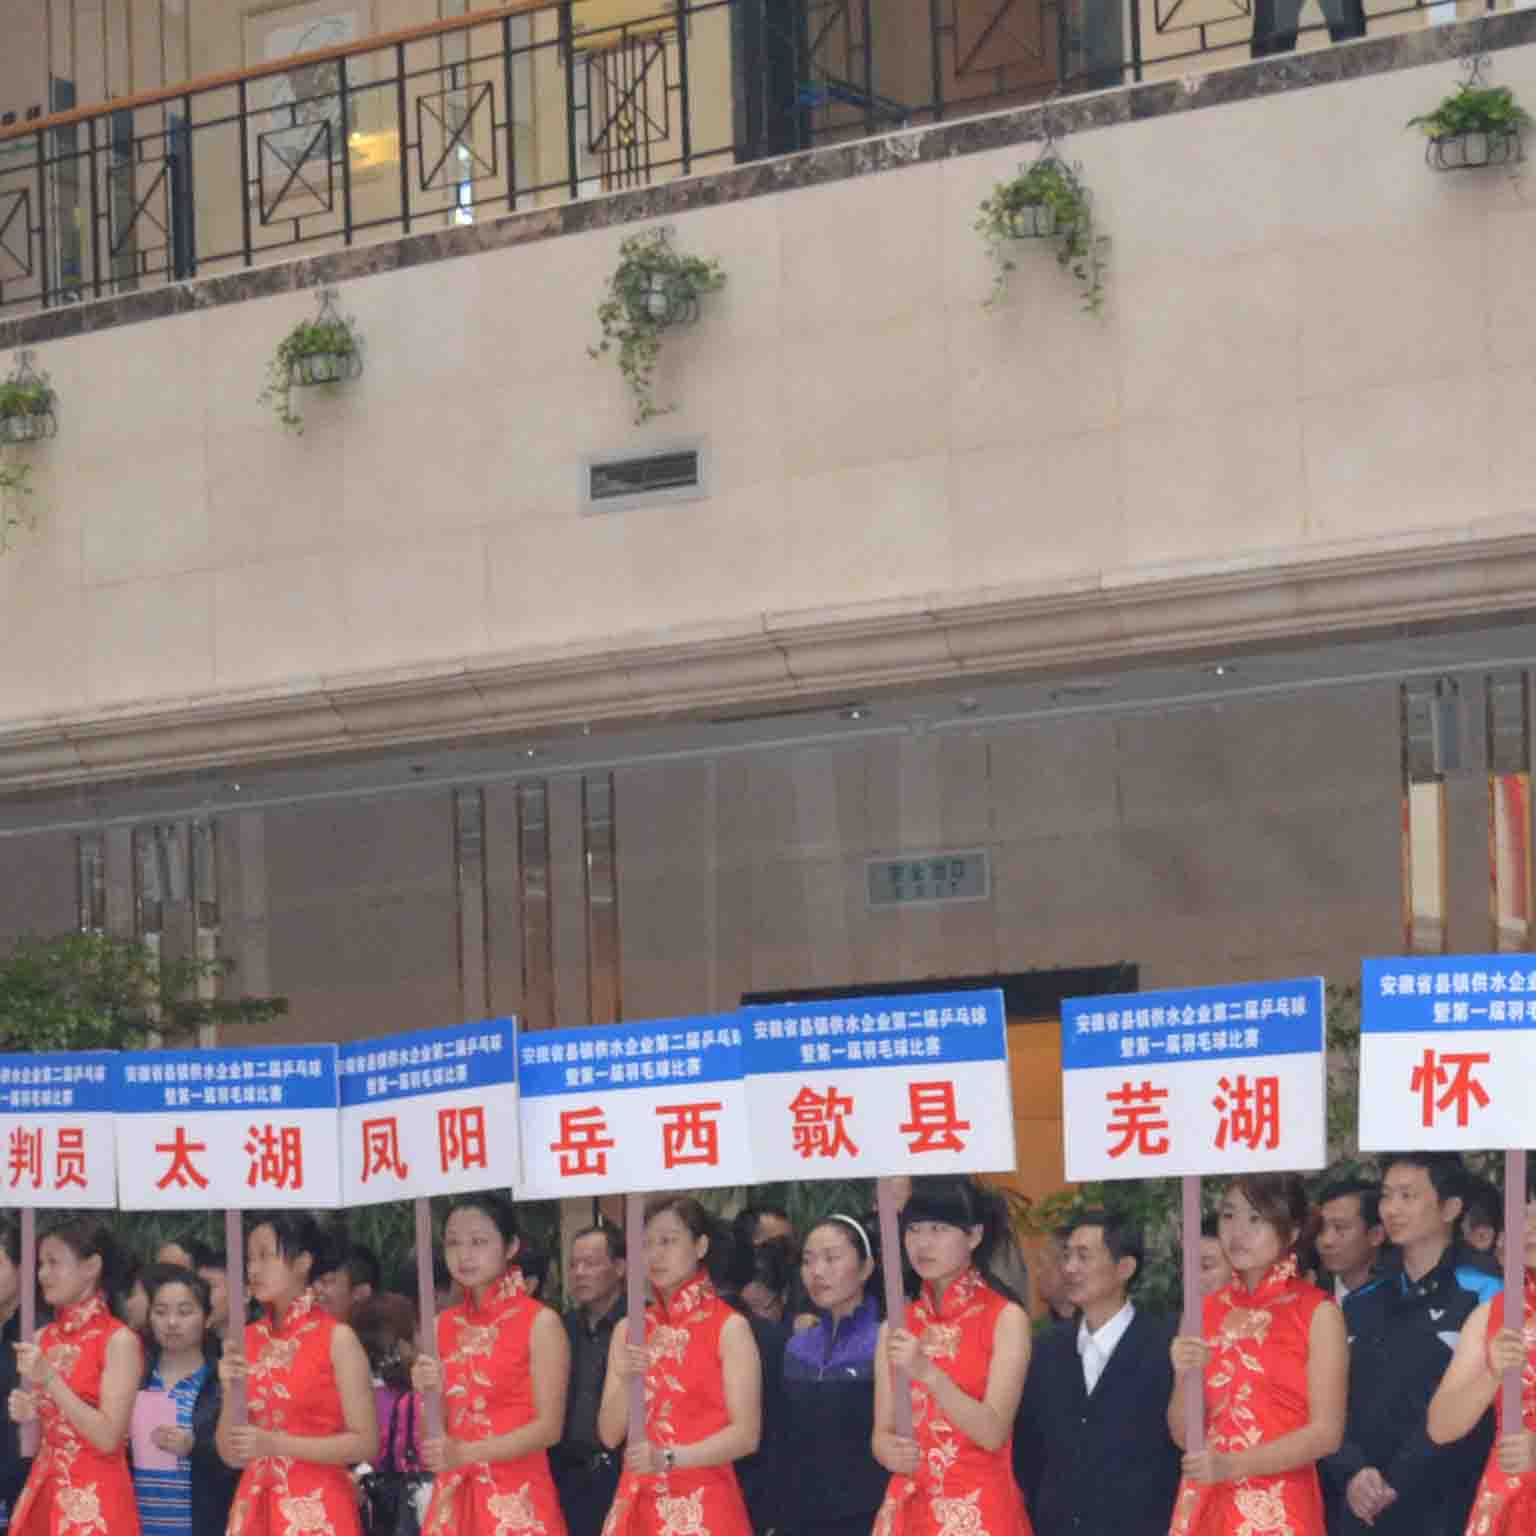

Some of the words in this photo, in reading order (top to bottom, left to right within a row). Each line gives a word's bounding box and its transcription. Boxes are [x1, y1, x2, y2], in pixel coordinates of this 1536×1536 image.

[752, 1005, 988, 1040] 安徽省县镇供水企业第二届乒乓球
[1074, 996, 1307, 1035] 安徽省县镇供水企业第二届乒乓球
[360, 1106, 488, 1183] 凤阳
[549, 1101, 724, 1178] 岳西
[788, 1079, 972, 1160] 歙县
[1104, 1073, 1281, 1160] 芜湖
[154, 1124, 305, 1191] 太湖
